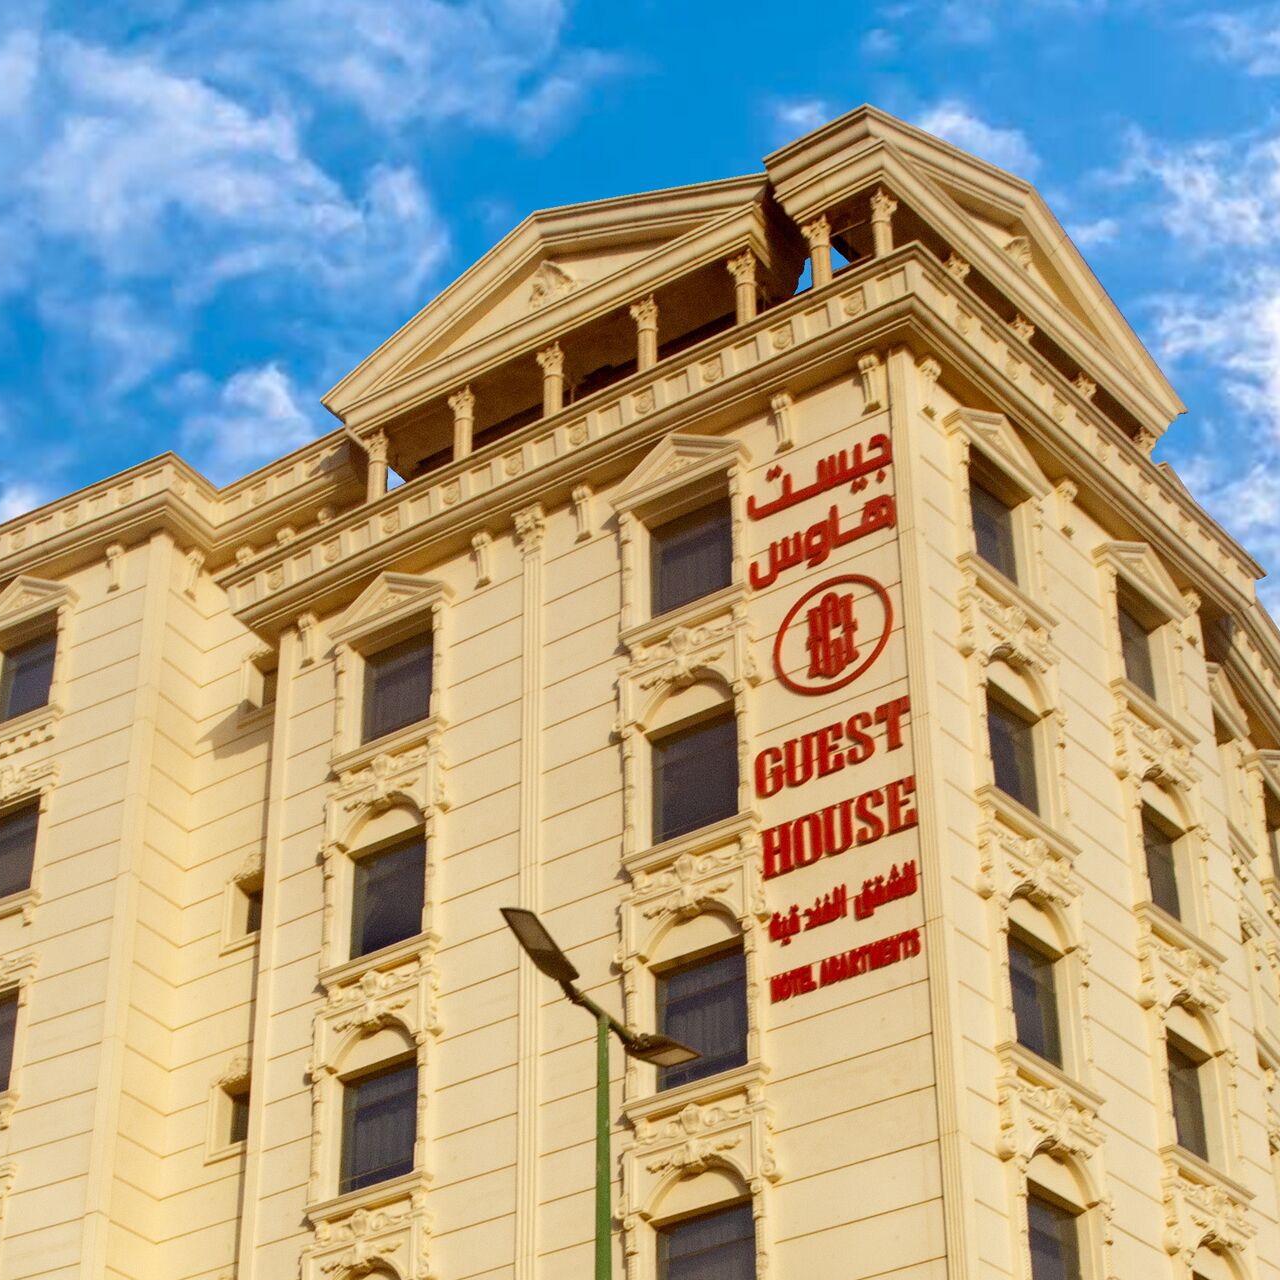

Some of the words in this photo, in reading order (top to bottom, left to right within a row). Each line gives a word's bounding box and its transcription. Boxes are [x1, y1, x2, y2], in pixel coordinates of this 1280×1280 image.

[747, 433, 893, 521] جيست
[749, 494, 897, 591] هاوس
[754, 695, 911, 799] GUEST
[762, 774, 919, 880] HOUSE
[770, 963, 817, 1005] HOTEL
[819, 927, 921, 989] APARTMENTS
